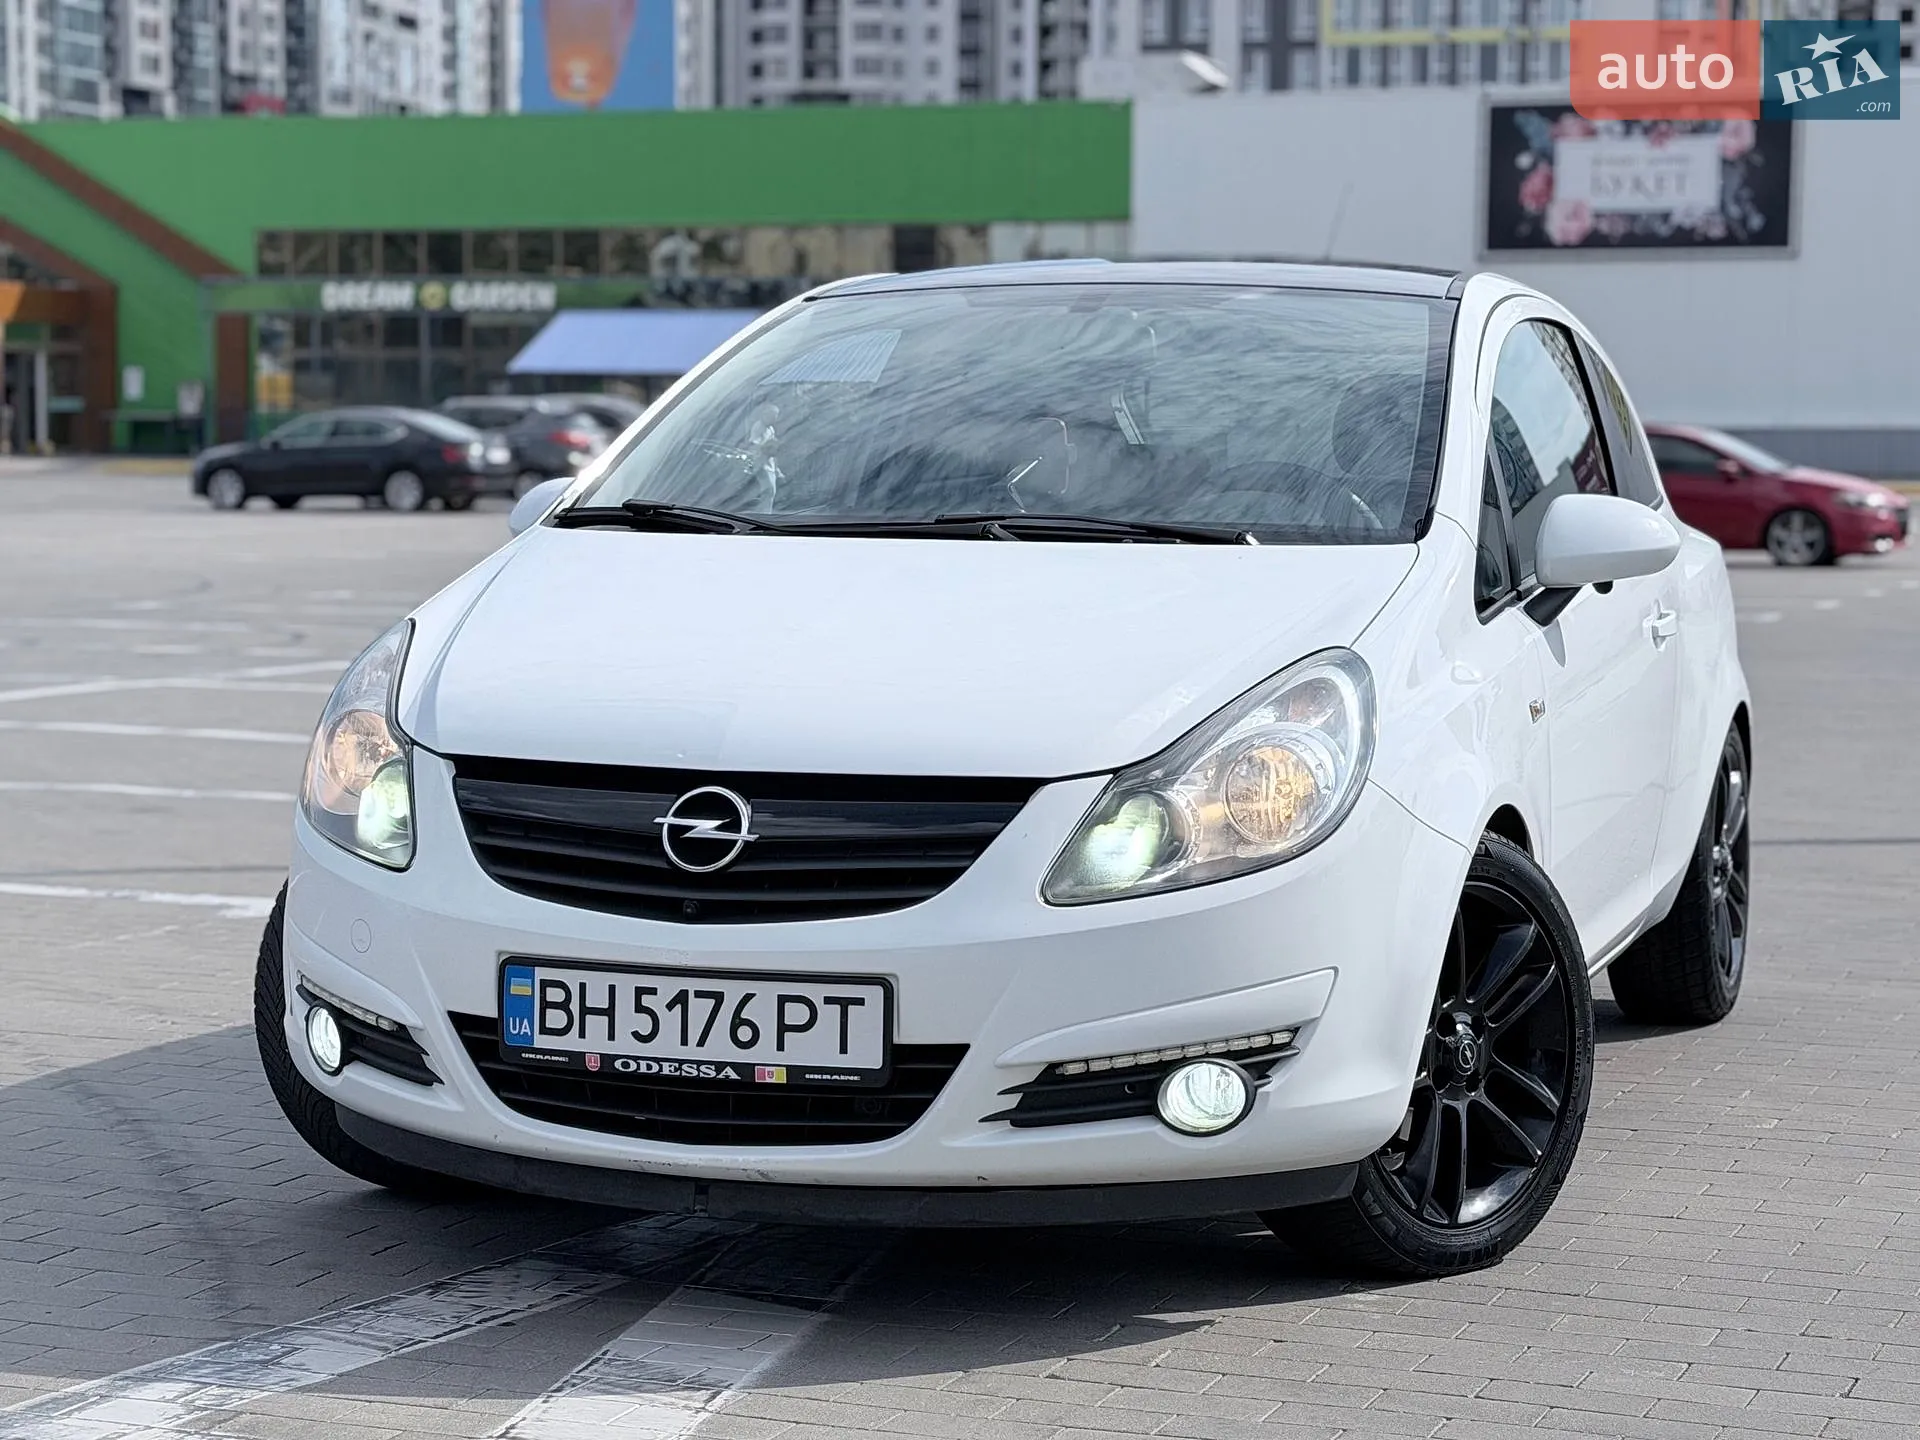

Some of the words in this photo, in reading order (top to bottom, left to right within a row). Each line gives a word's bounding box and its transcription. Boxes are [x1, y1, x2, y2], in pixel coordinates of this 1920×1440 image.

[508, 1017, 532, 1037] UA
[538, 978, 616, 1041] BH
[630, 986, 760, 1050] 5176
[776, 993, 866, 1055] PT
[614, 1057, 742, 1081] ODESSA
